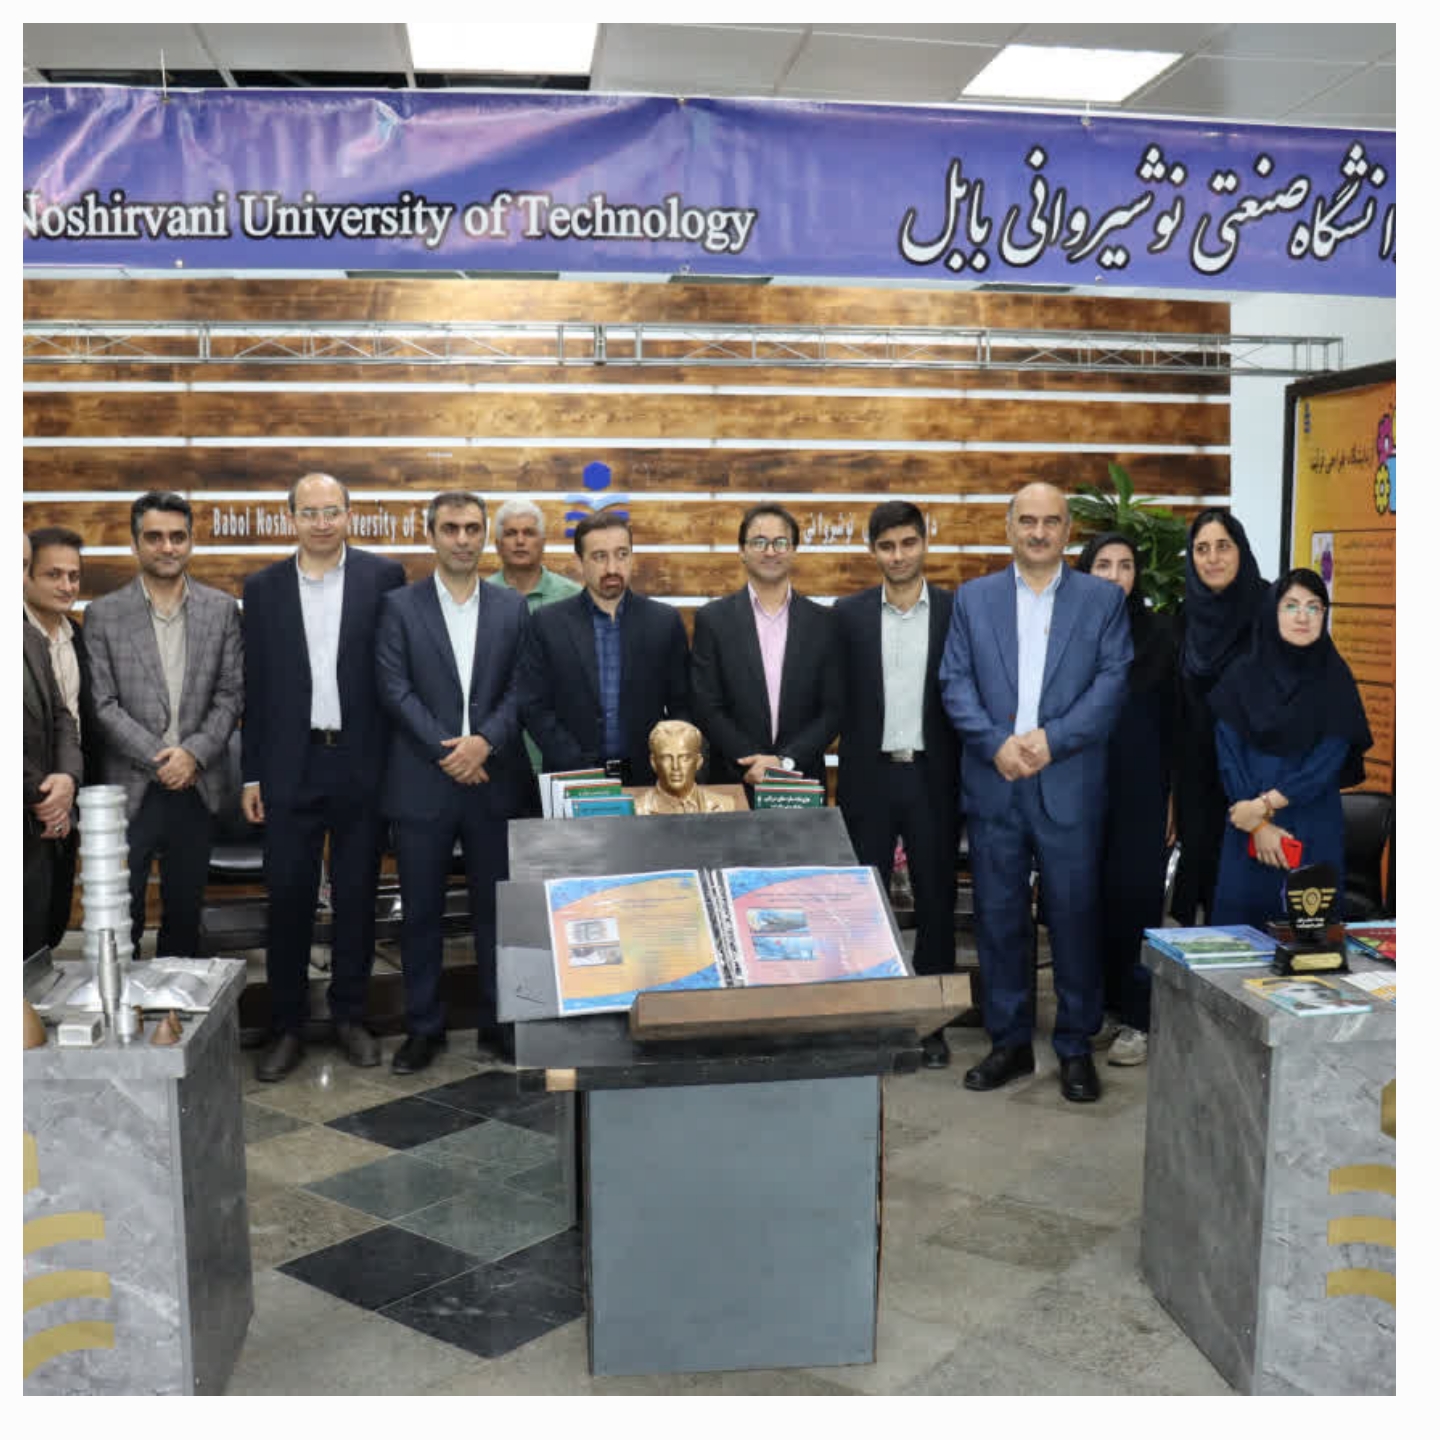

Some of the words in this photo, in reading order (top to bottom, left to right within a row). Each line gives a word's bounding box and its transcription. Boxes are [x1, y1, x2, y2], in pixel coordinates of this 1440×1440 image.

[23, 191, 229, 237] Noshirvani
[238, 193, 453, 248] University
[462, 193, 513, 238] of
[516, 194, 756, 252] Technology
[899, 160, 990, 271] بابل
[1000, 146, 1187, 268] نوشیروانی
[1191, 157, 1310, 273] صنعتی
[1289, 142, 1396, 258] انشگاه
[212, 505, 251, 537] Babol
[346, 508, 397, 544] versity
[403, 508, 416, 538] of
